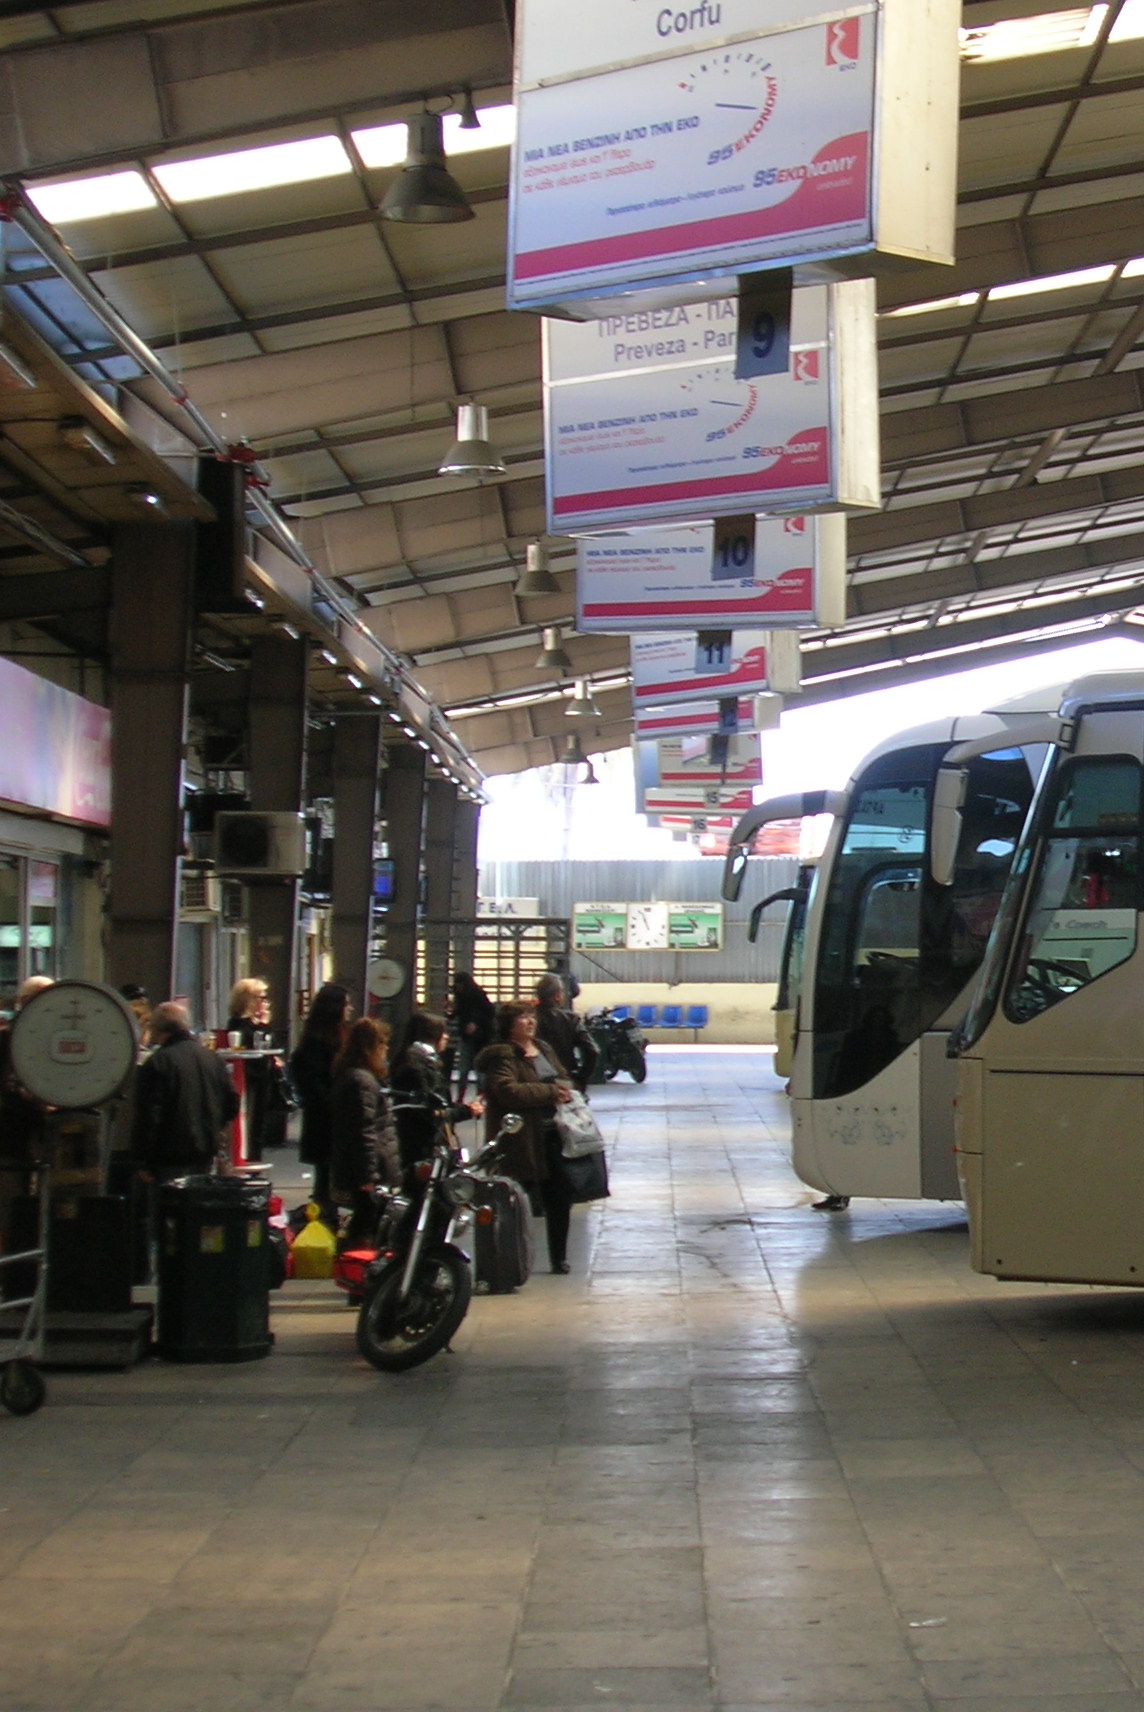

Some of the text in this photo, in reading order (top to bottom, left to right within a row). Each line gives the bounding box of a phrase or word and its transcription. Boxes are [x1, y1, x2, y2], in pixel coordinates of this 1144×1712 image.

[656, 0, 721, 37] Corfu
[547, 144, 570, 158] ΝΕΑ
[572, 132, 622, 152] ΒΕΝΖΙΝΗ
[623, 126, 648, 142] ΑΠΟ
[649, 120, 674, 137] ΤΗΝ
[598, 305, 690, 338] ΠΡΕΒΕΖΑ
[752, 311, 776, 359] 9
[613, 338, 687, 362] Preveza
[719, 535, 749, 568] 10
[703, 643, 725, 665] 11
